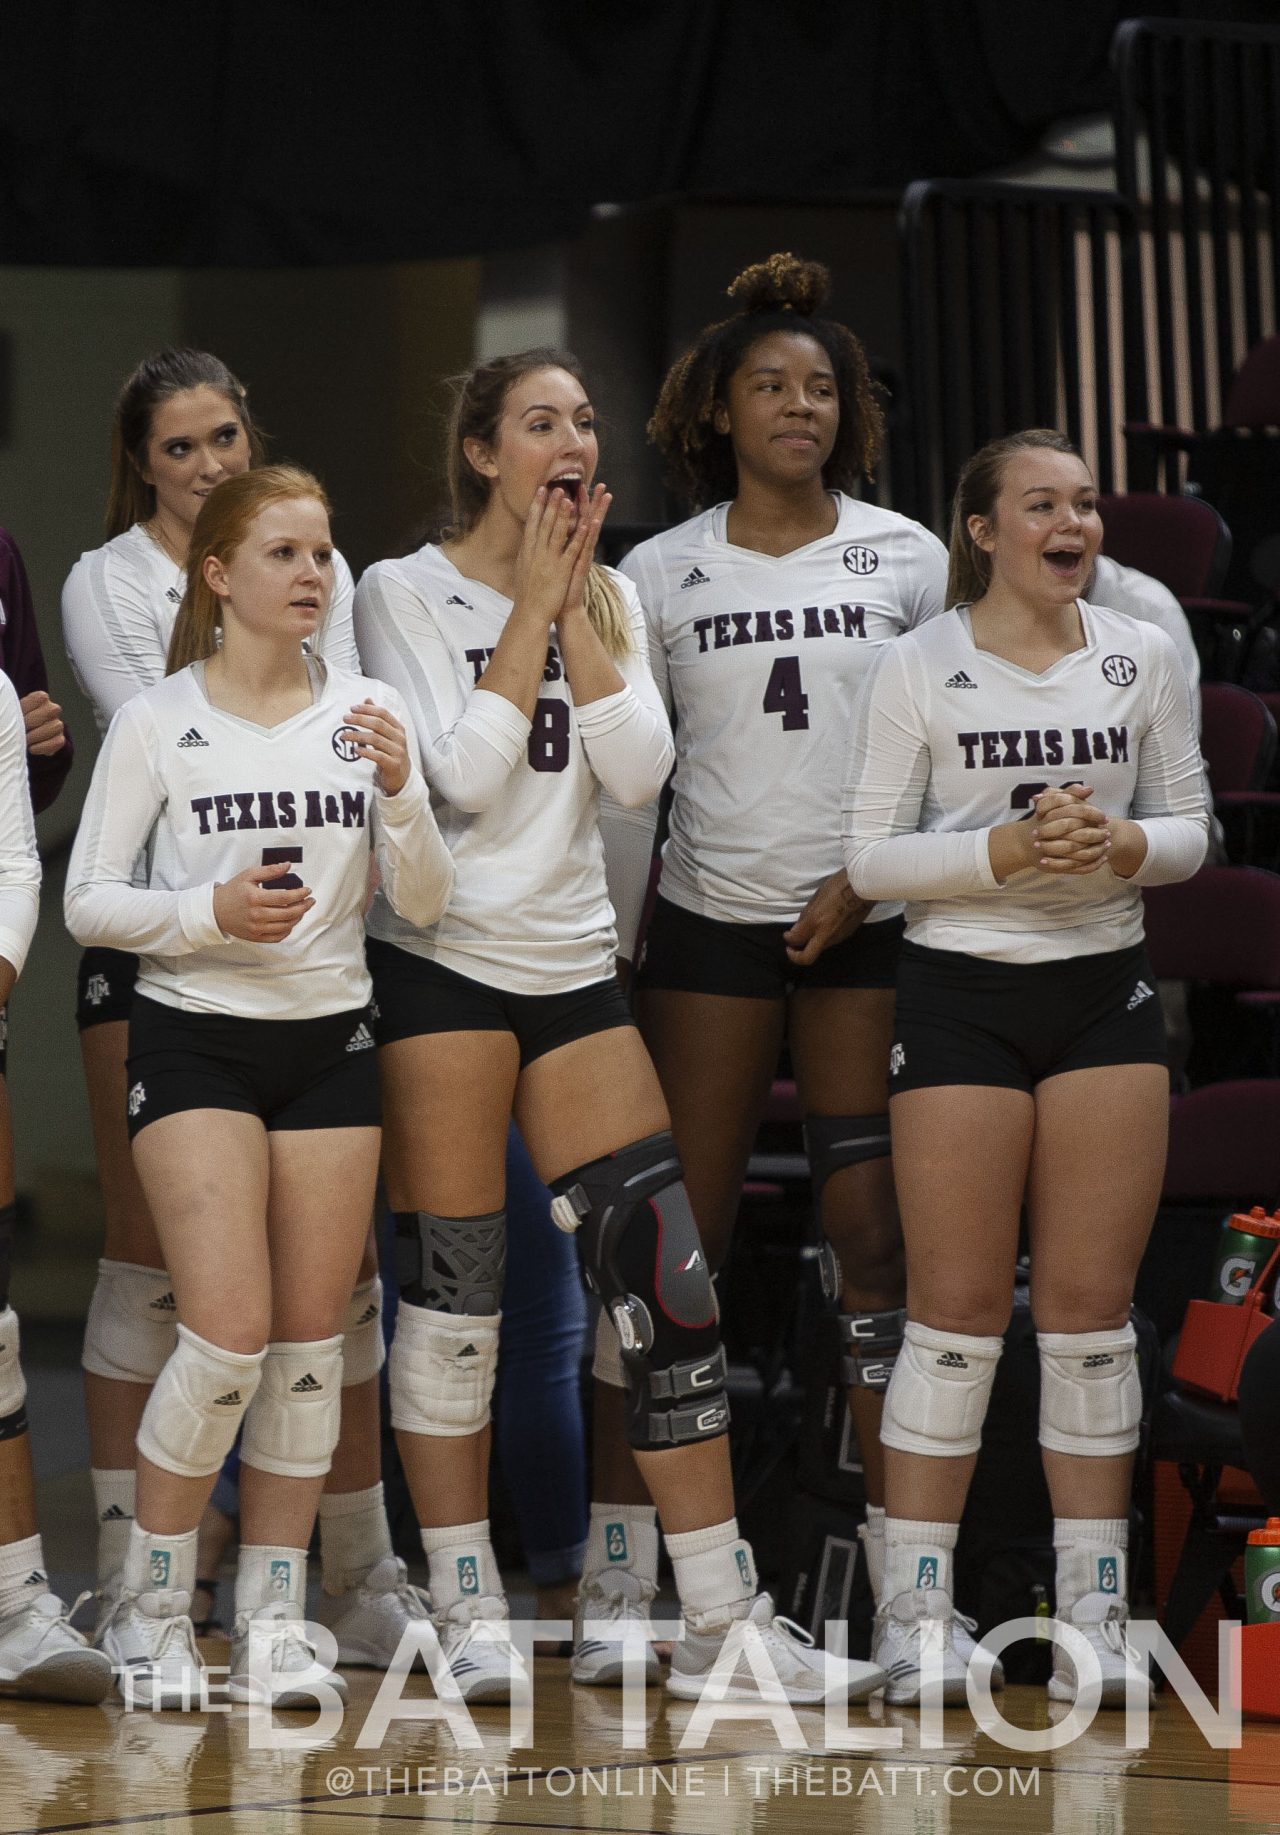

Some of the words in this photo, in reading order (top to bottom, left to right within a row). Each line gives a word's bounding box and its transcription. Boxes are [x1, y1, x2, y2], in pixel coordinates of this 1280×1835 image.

[843, 546, 878, 575] SEC
[680, 576, 710, 589] adidas
[693, 609, 794, 653] TEXAS
[803, 604, 867, 638] A&M
[945, 681, 978, 689] adidas
[1102, 655, 1137, 687] SEC
[763, 656, 809, 731] 4
[177, 739, 209, 748] adidas
[958, 729, 1064, 769] TEXAS
[1072, 726, 1129, 764] A&M
[191, 791, 297, 835] TEXAS
[305, 791, 365, 828] A&M
[1221, 1257, 1256, 1296] G
[936, 1358, 968, 1369] adidas
[1083, 1357, 1114, 1368] adidas
